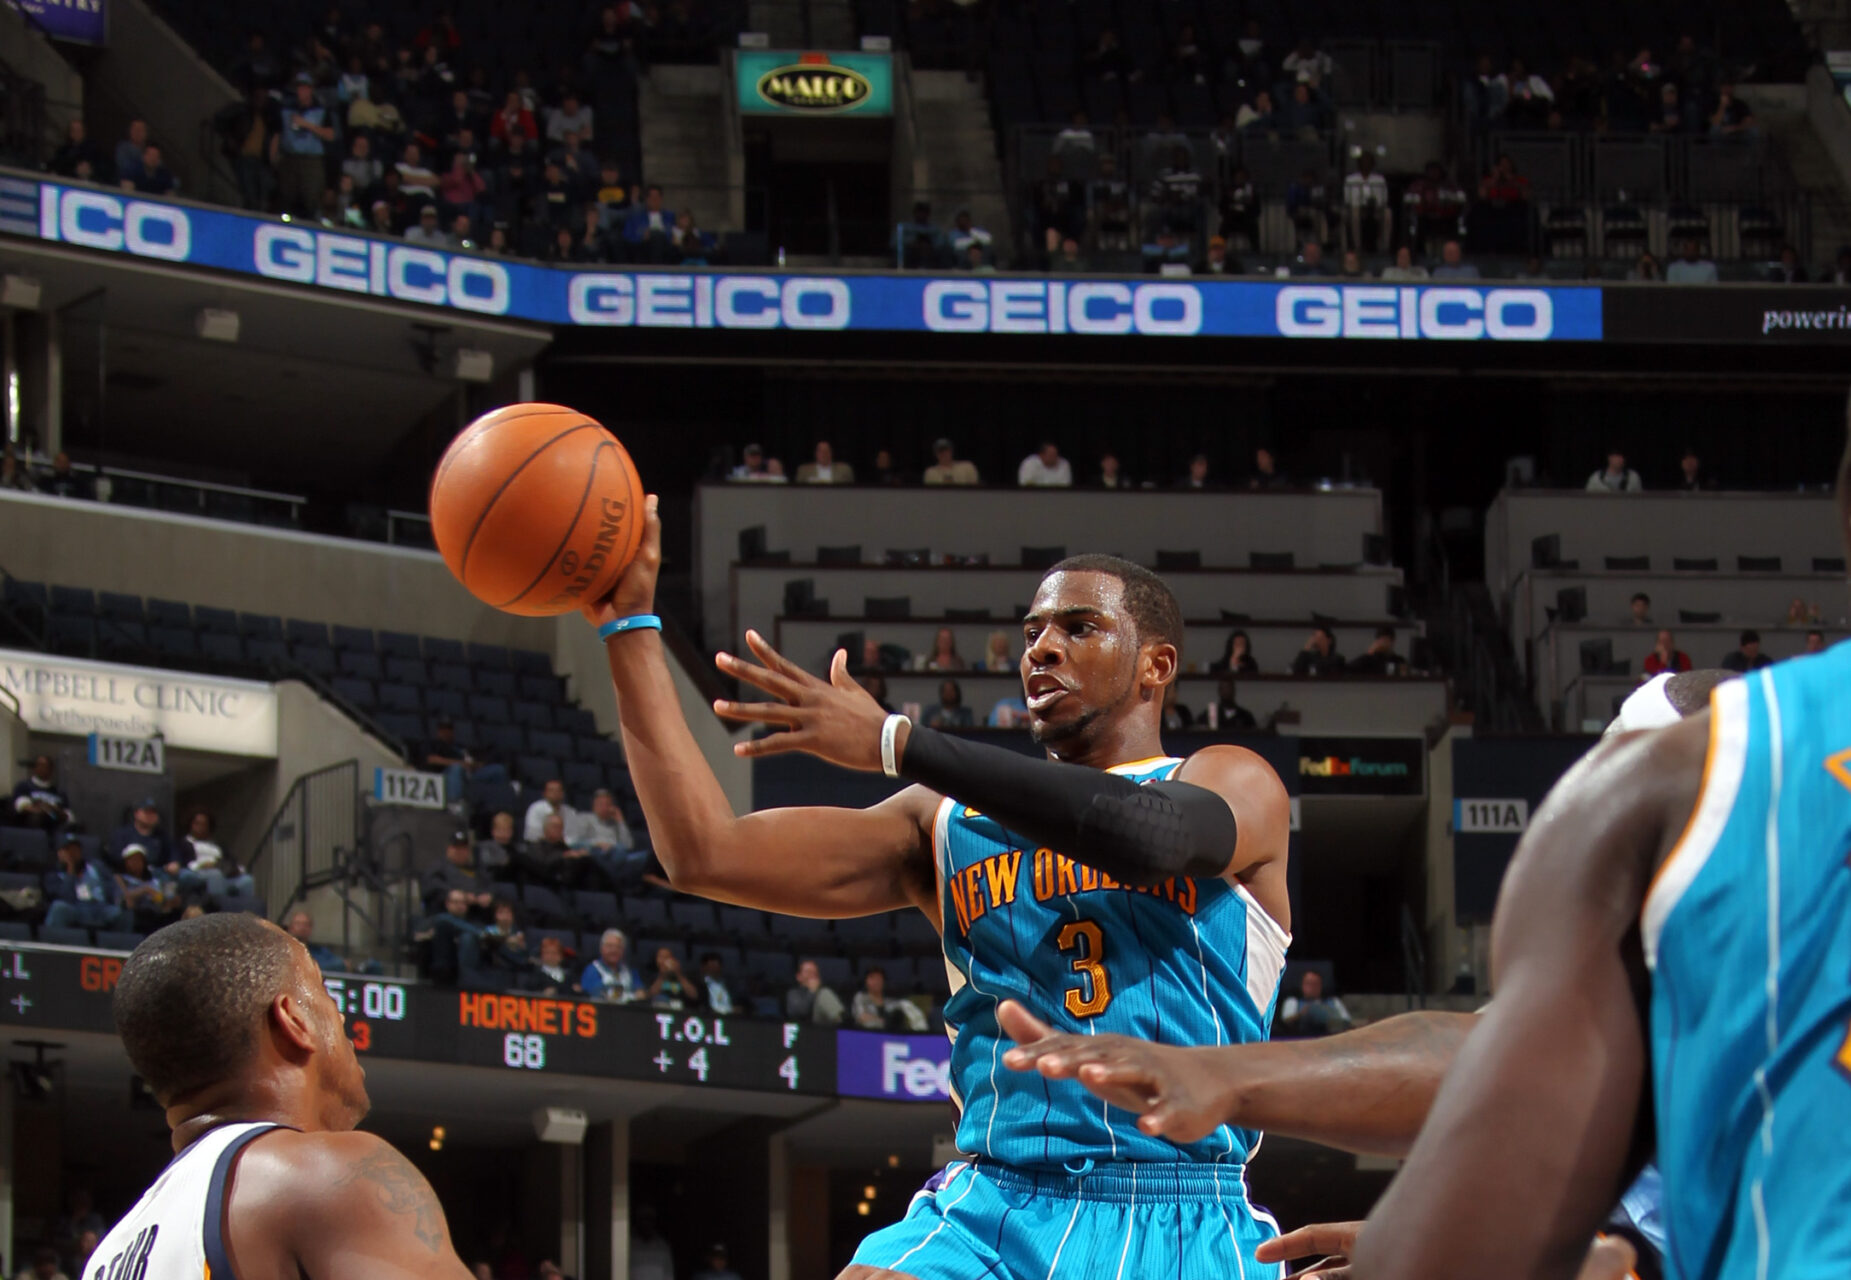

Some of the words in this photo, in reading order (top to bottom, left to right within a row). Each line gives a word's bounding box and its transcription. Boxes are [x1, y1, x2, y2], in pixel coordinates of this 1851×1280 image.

[254, 224, 510, 315] GEICO
[568, 273, 851, 328] GEICO
[922, 280, 1203, 334] GEICO
[1275, 287, 1554, 341] GEICO
[133, 680, 240, 718] CLINIC
[102, 739, 158, 767] 112A
[1299, 756, 1407, 776] FedExForum
[386, 774, 439, 803] 112A
[1468, 804, 1520, 827] 111A
[949, 850, 1022, 938] NEW
[1057, 920, 1112, 1019] 3
[459, 991, 597, 1038] HORNETS
[352, 1021, 371, 1050] 3
[504, 1032, 545, 1069] 68
[783, 1022, 799, 1049] F
[688, 1047, 708, 1081] 4
[779, 1056, 799, 1089] 4
